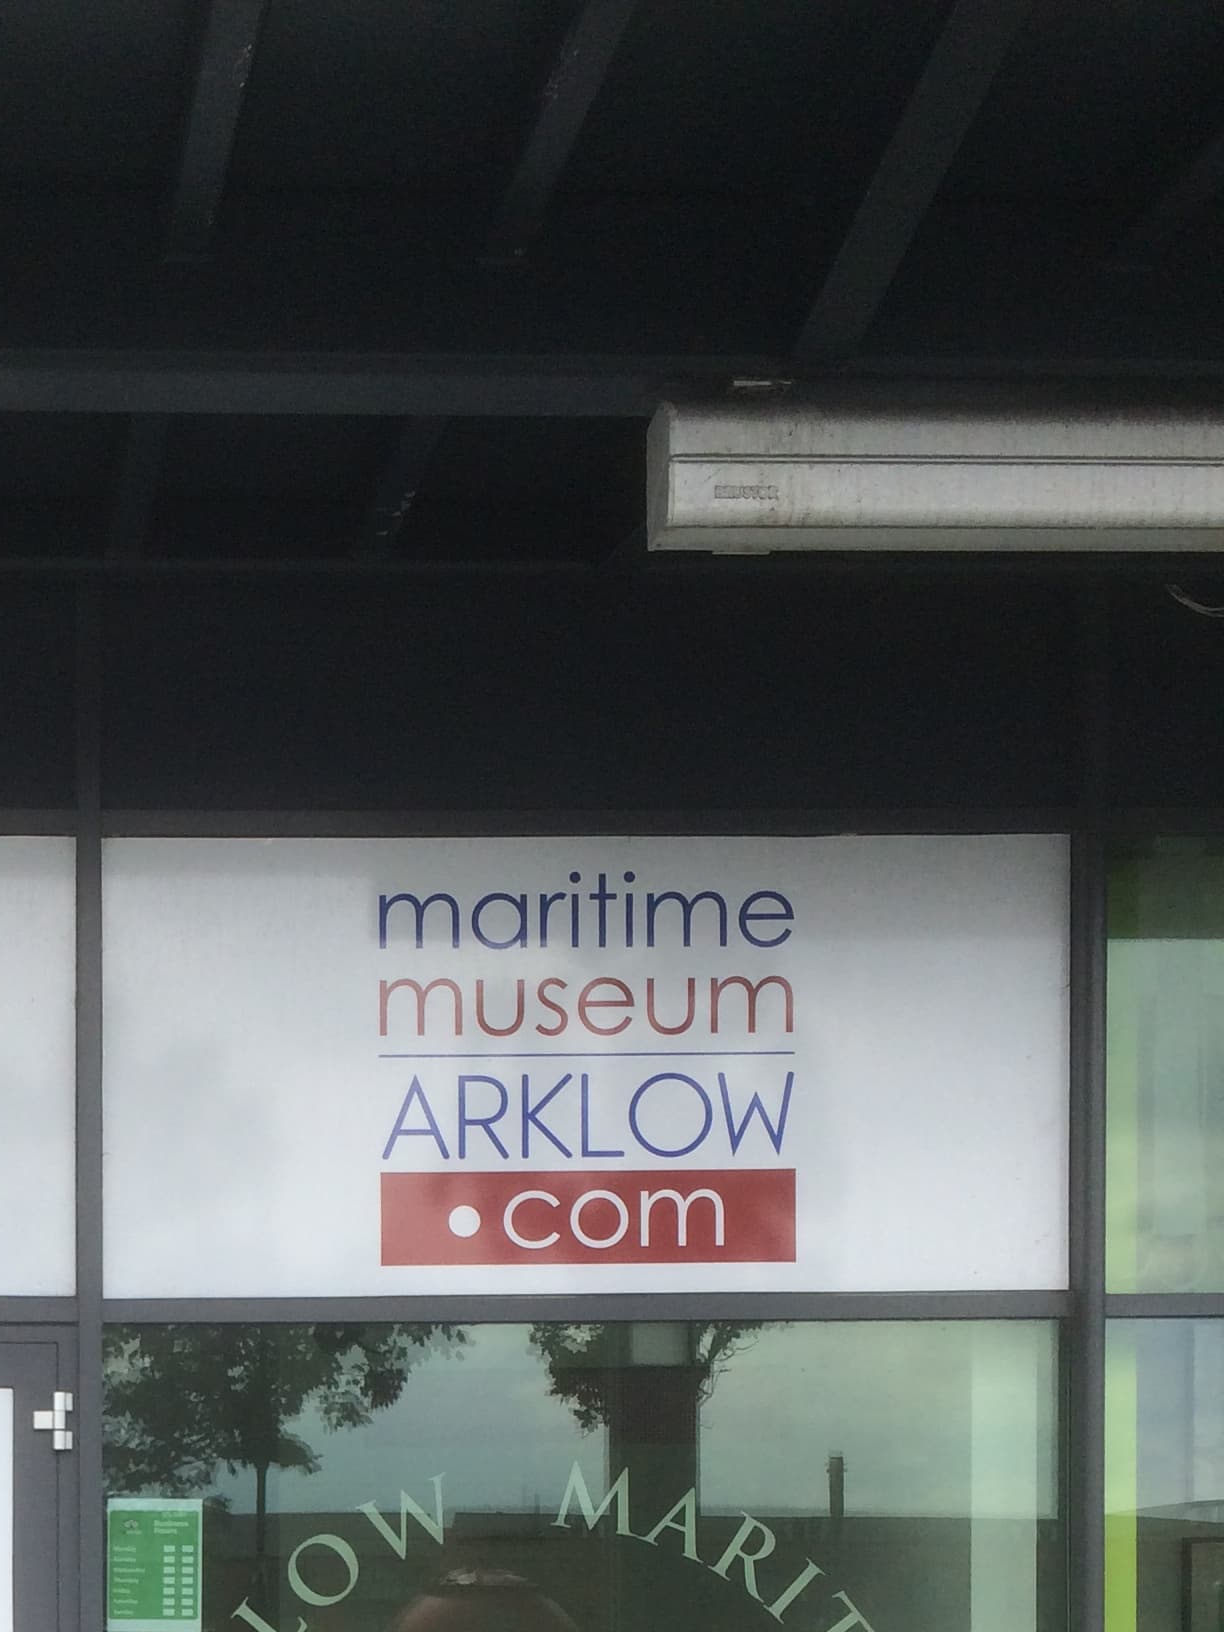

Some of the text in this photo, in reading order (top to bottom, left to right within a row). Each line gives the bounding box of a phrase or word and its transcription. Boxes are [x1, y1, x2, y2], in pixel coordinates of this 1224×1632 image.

[379, 871, 794, 950] maritime
[379, 975, 794, 1037] museum
[382, 1072, 794, 1160] ARKLOW
[448, 1188, 725, 1250] .com
